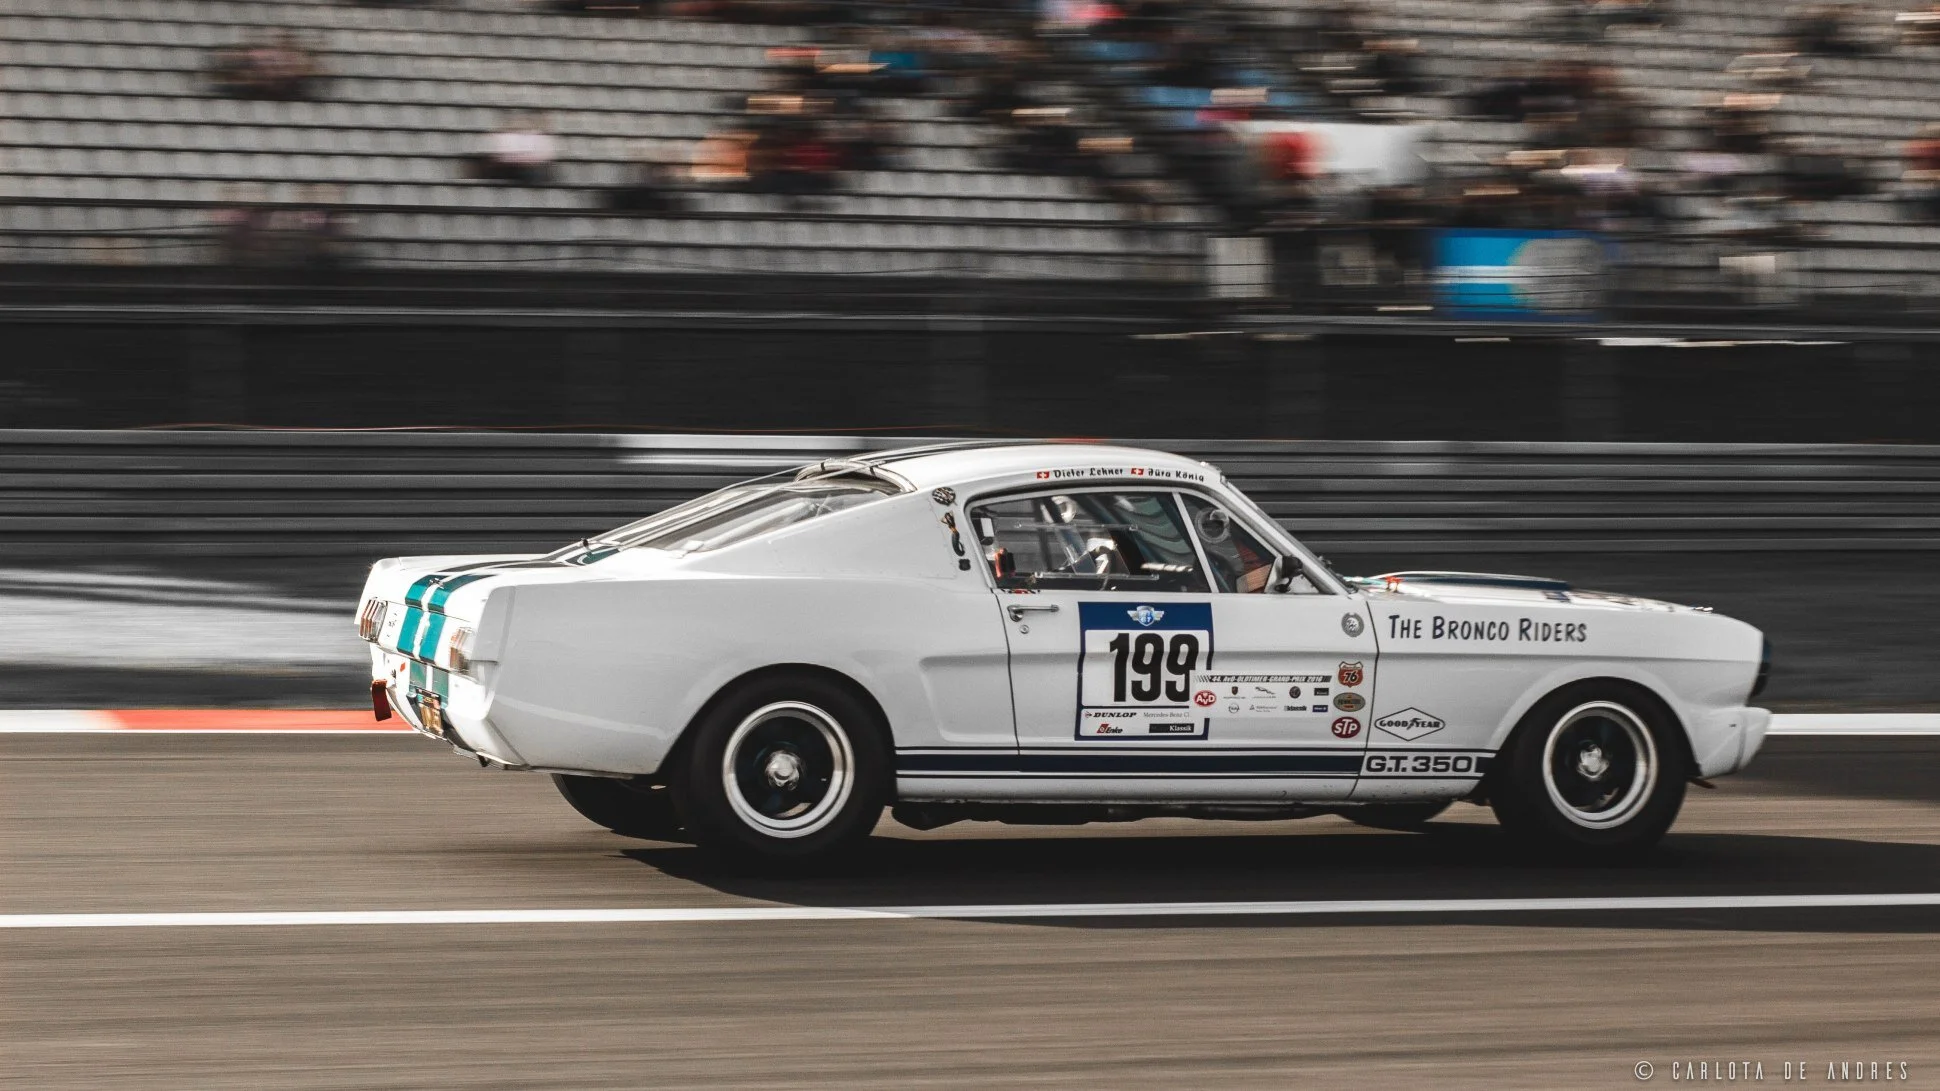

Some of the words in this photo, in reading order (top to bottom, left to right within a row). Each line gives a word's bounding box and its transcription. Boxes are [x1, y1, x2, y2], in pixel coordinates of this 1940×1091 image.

[1109, 632, 1200, 702] 199
[1344, 671, 1358, 682] 76
[1334, 718, 1358, 735] STP
